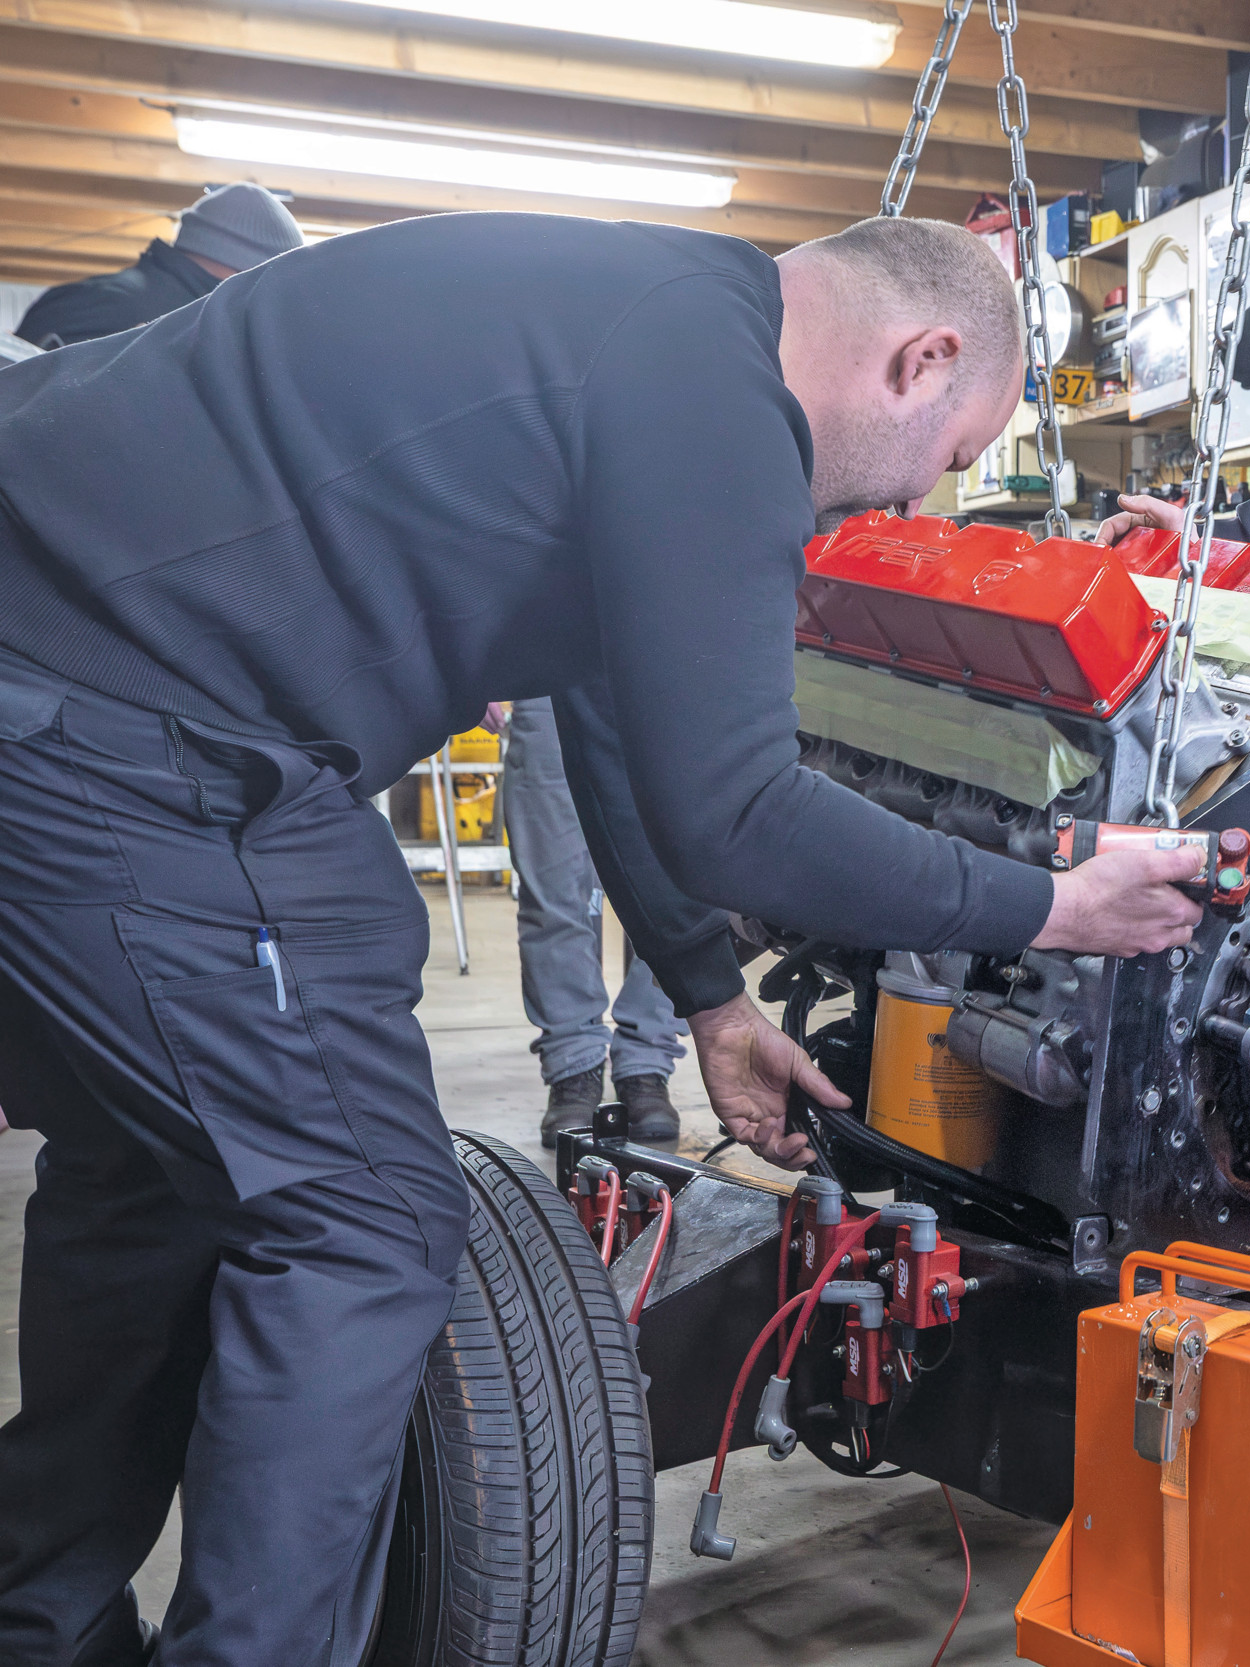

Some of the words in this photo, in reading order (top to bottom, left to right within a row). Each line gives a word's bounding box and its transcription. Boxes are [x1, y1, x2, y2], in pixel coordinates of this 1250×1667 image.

[1054, 373, 1086, 399] 37
[805, 1231, 814, 1270] MSD
[898, 1258, 907, 1299] MSD
[849, 1336, 859, 1376] MSD
